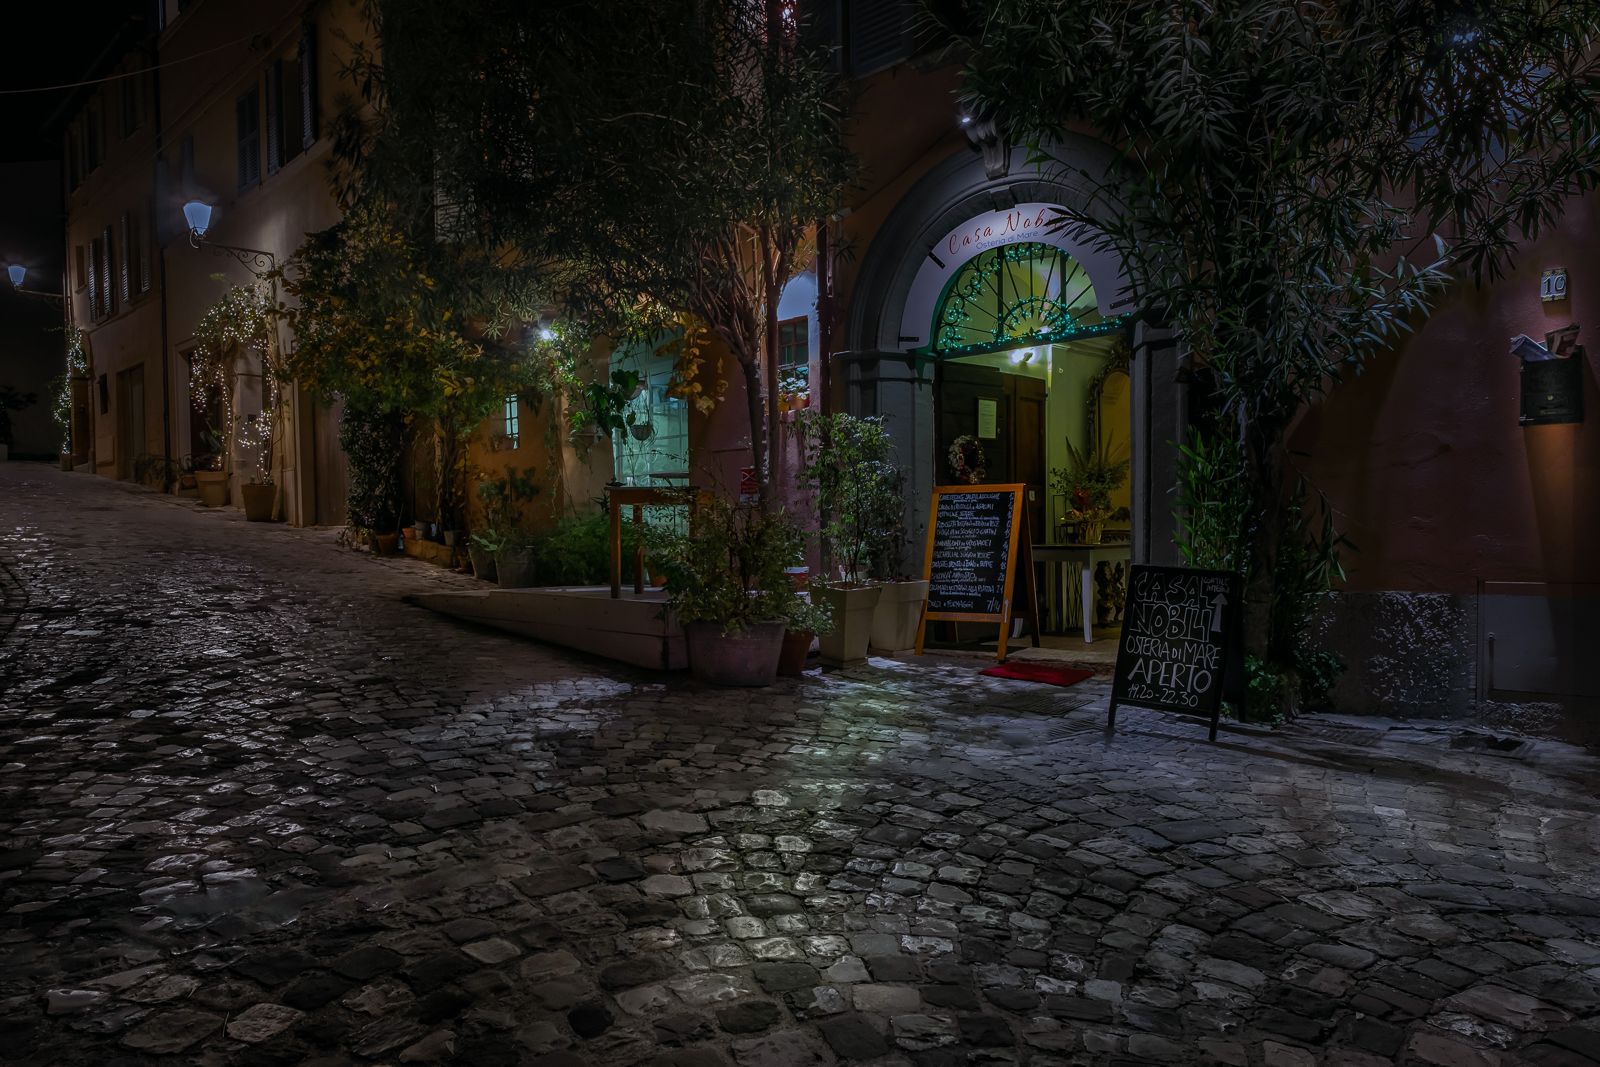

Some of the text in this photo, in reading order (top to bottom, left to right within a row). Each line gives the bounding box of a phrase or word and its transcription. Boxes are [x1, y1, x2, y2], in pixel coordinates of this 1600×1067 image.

[949, 207, 1056, 255] Casa Nob
[976, 238, 1006, 250] Osteria
[1017, 231, 1039, 240] Mare
[1544, 275, 1566, 295] 10
[1134, 572, 1200, 608] CASA
[1129, 603, 1212, 642] NOBILI
[1126, 635, 1221, 669] OSTERIA DI MARE
[1128, 658, 1212, 693] APERTO
